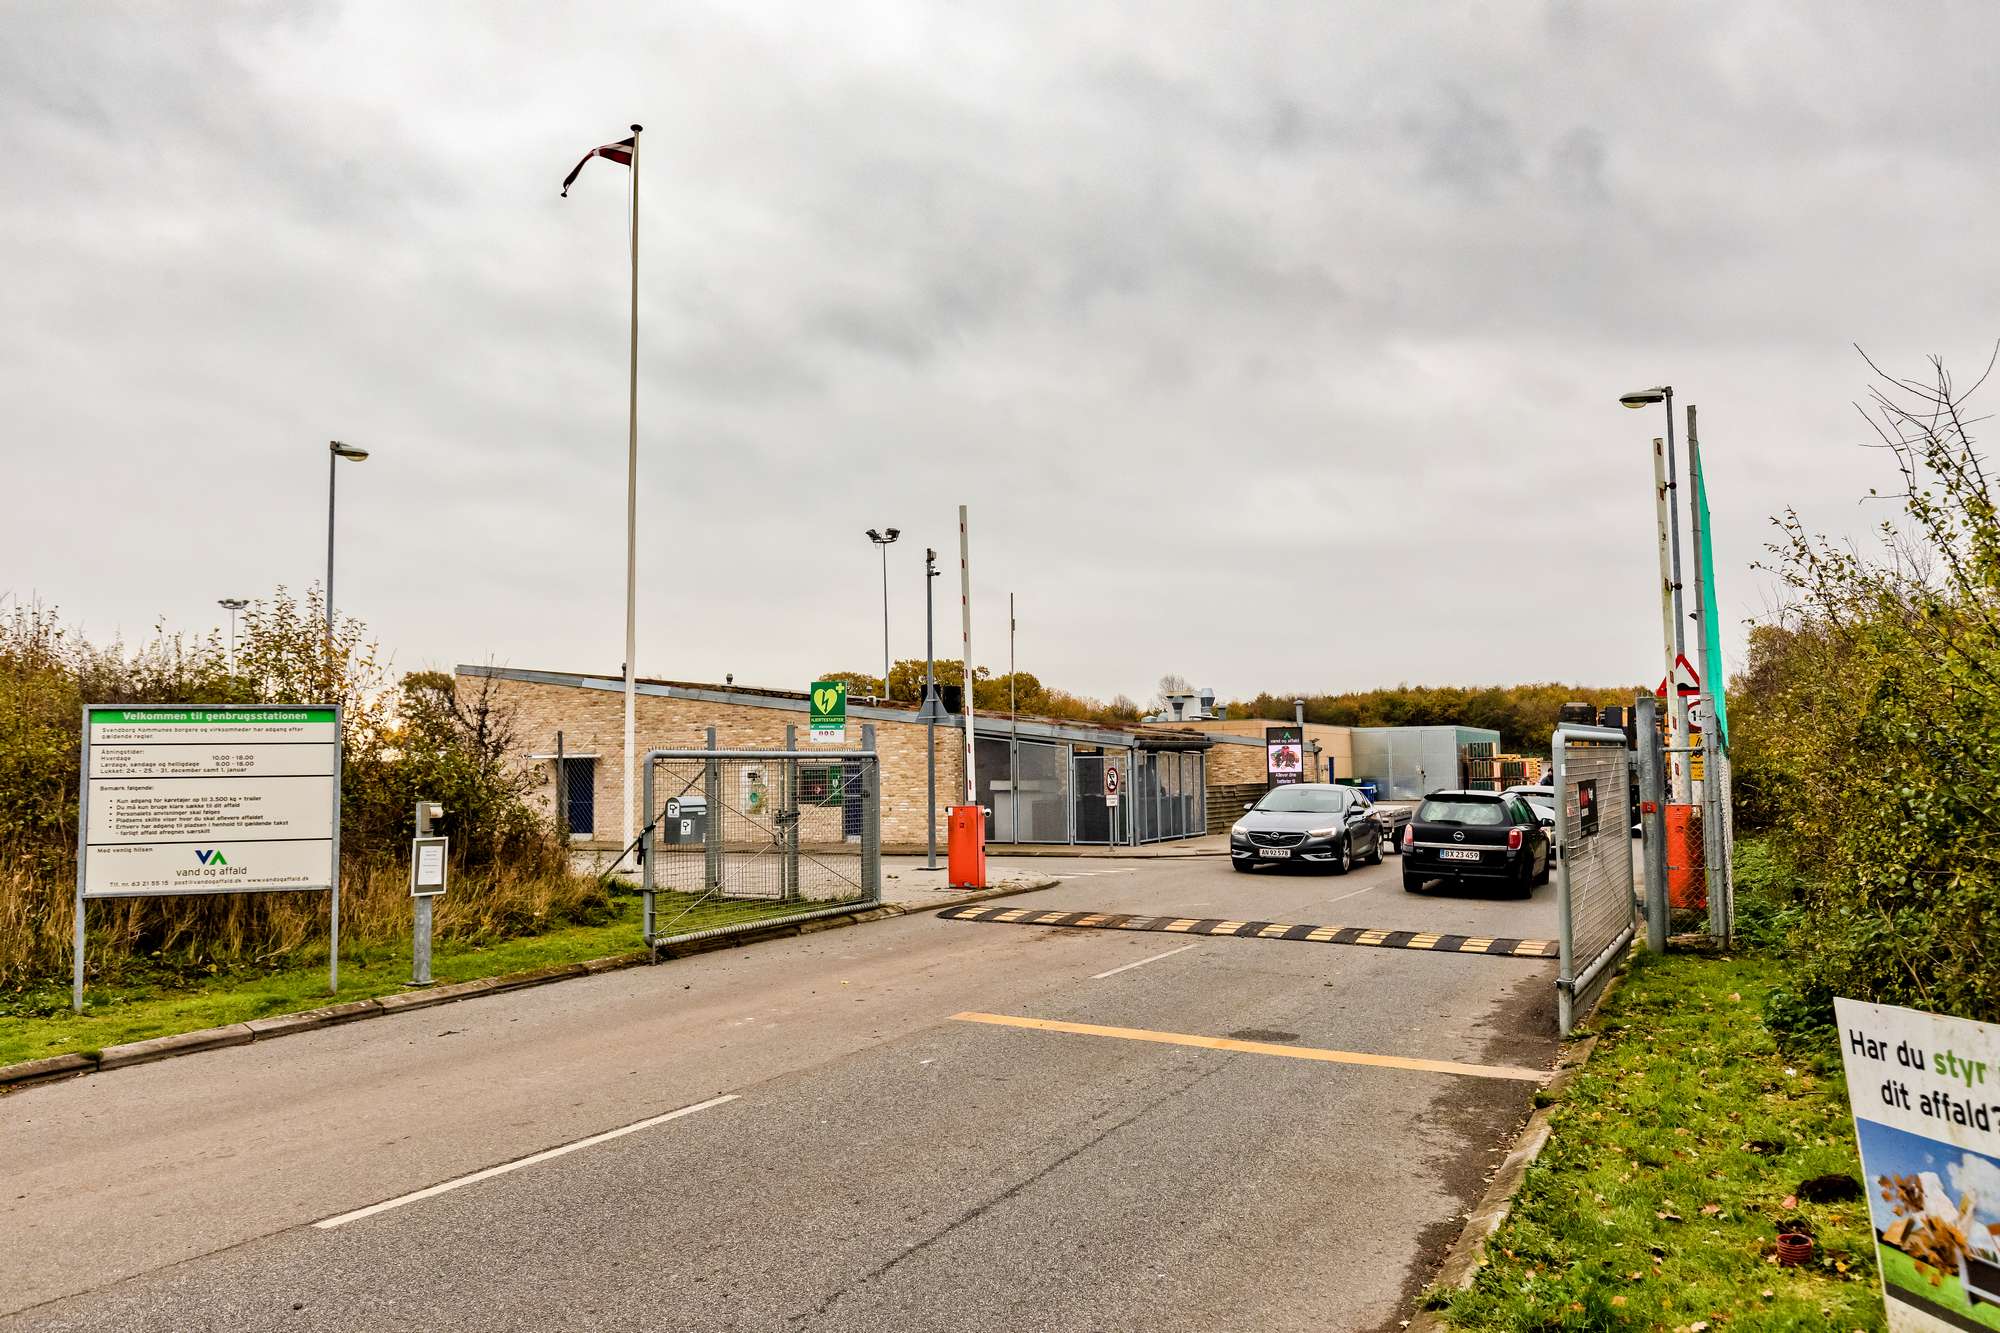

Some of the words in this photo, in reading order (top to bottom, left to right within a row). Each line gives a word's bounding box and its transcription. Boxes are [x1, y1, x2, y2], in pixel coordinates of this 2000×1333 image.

[123, 711, 188, 721] Velkommen
[190, 711, 203, 720] til
[205, 711, 308, 722] genbrugsstationen
[1445, 850, 1455, 858] BX
[1455, 851, 1465, 859] 23
[1465, 852, 1479, 860] 459
[176, 868, 201, 877] vand
[203, 868, 217, 878] og
[219, 866, 248, 875] affald
[1849, 1029, 1887, 1061] Har
[1896, 1040, 1925, 1071] du
[1933, 1049, 1986, 1088] styr
[1881, 1079, 1911, 1111] dit
